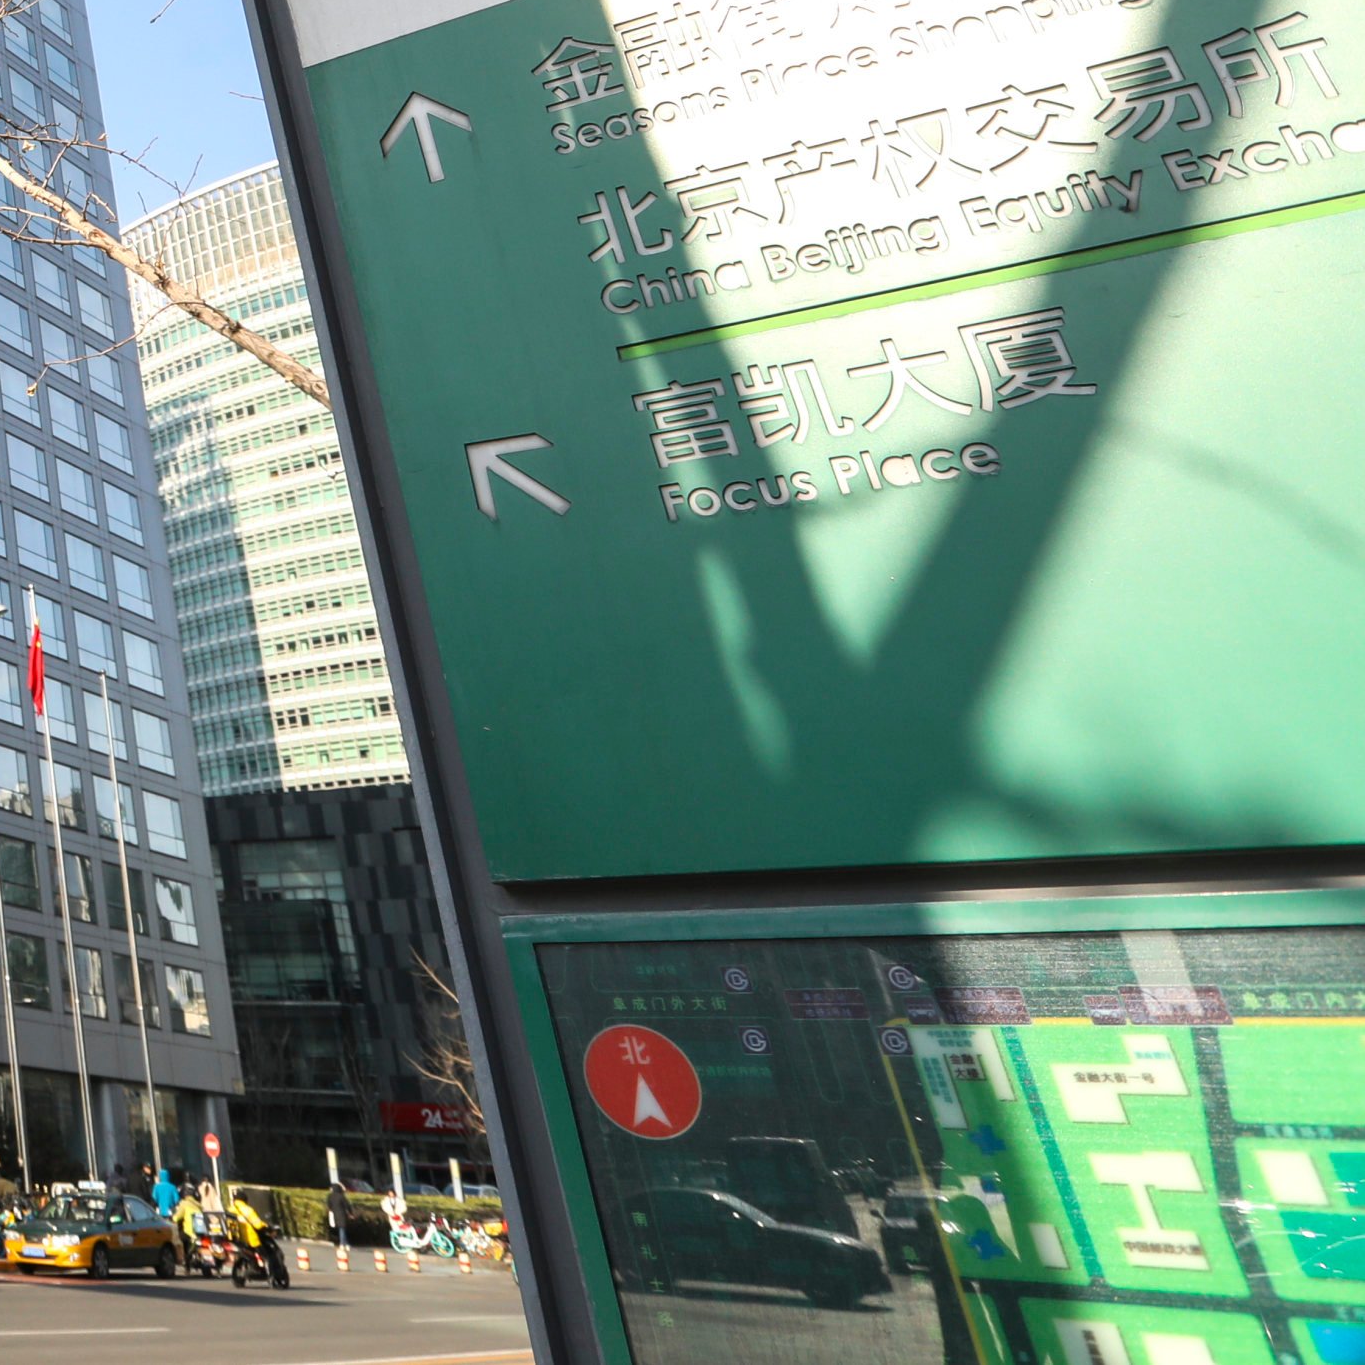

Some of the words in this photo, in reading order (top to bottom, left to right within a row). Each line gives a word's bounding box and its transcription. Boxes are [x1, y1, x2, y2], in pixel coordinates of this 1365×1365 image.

[551, 86, 730, 155] Seasons
[740, 46, 879, 101] Place
[577, 11, 1340, 264] 北京产权交易所
[600, 260, 752, 315] China
[760, 215, 950, 283] Beijing
[959, 169, 1143, 236] Equity
[631, 306, 1098, 469] 富凯大厦
[658, 471, 819, 522] Focus
[829, 441, 1002, 496] Place
[613, 996, 727, 1011] 阜成门外大街
[618, 1036, 651, 1065] 北
[1073, 1071, 1155, 1084] 金融大街一号
[421, 1108, 443, 1129] 24
